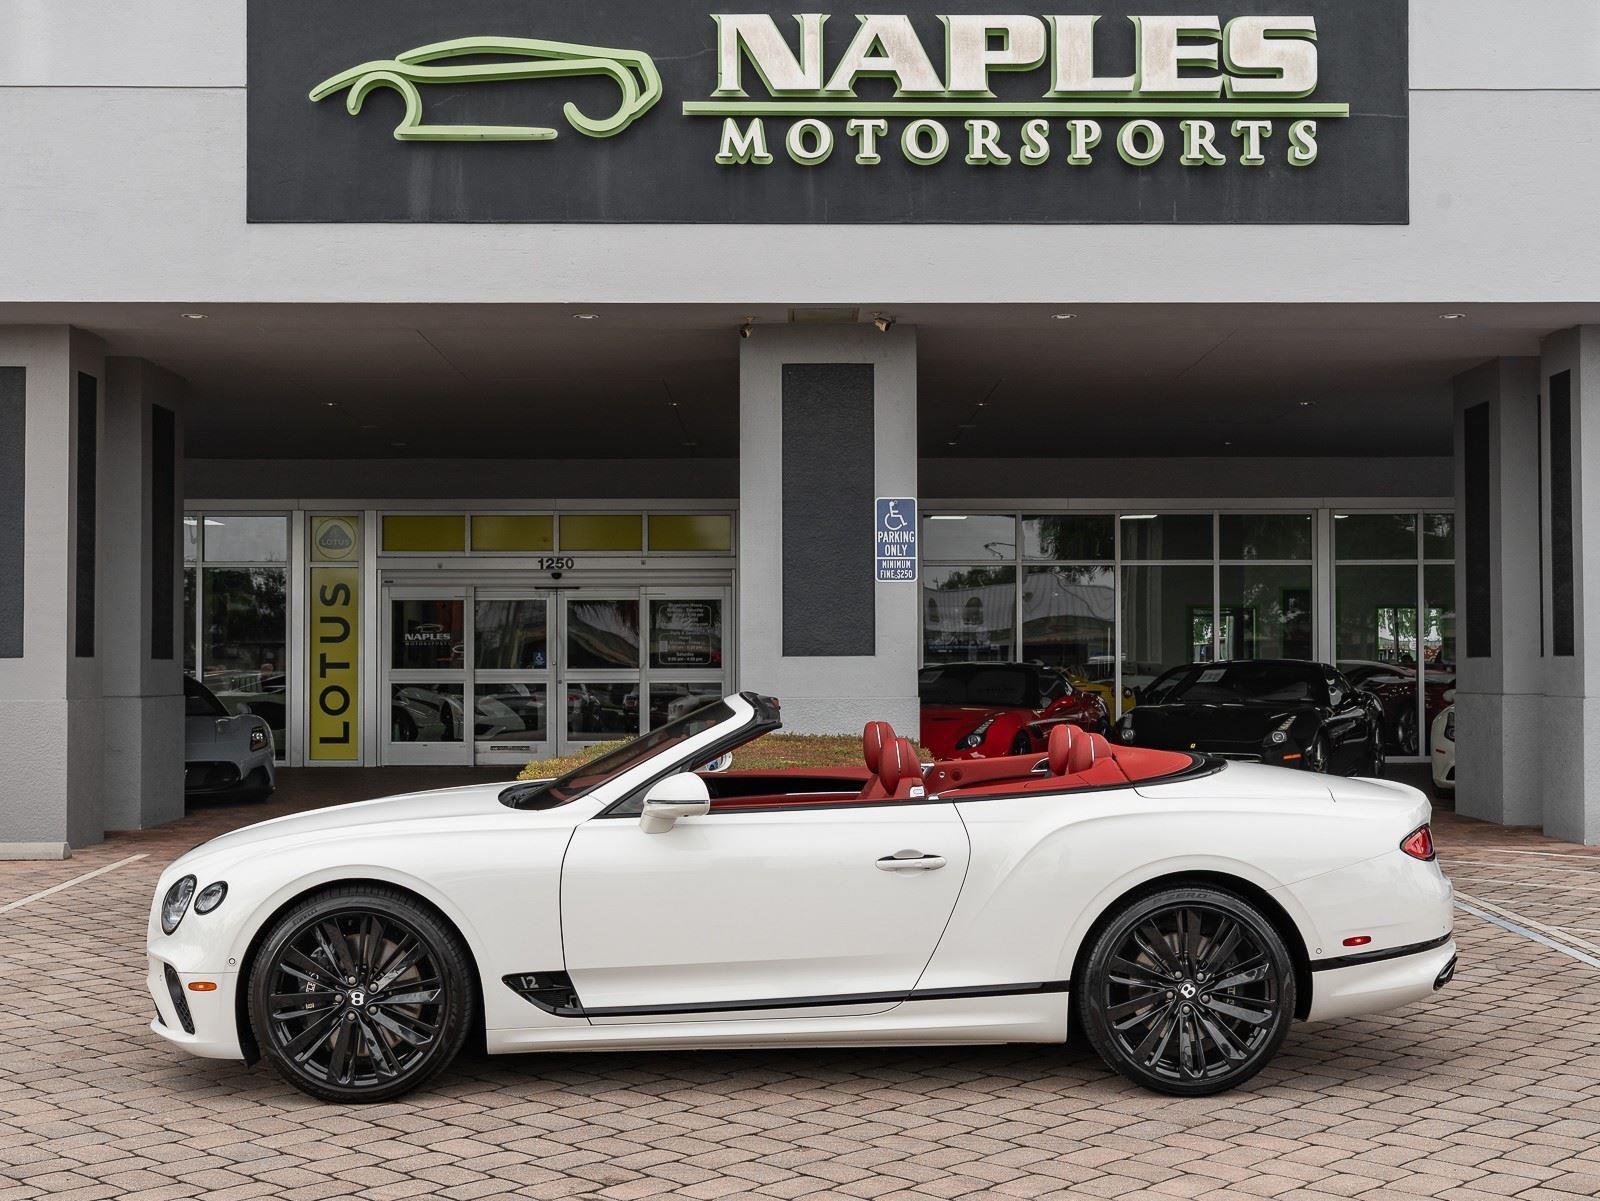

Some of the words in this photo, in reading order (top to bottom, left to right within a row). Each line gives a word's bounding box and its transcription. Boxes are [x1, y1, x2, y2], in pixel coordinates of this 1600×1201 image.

[708, 13, 1319, 99] NAPLES
[714, 117, 1319, 166] MOTORSPORTS
[877, 531, 915, 543] PARKING
[884, 544, 908, 556] ONLY
[537, 557, 575, 570] 1250
[882, 560, 911, 569] MINIMUM
[404, 633, 451, 641] NAPLES
[319, 583, 350, 744] LOTUS
[520, 976, 539, 989] 12
